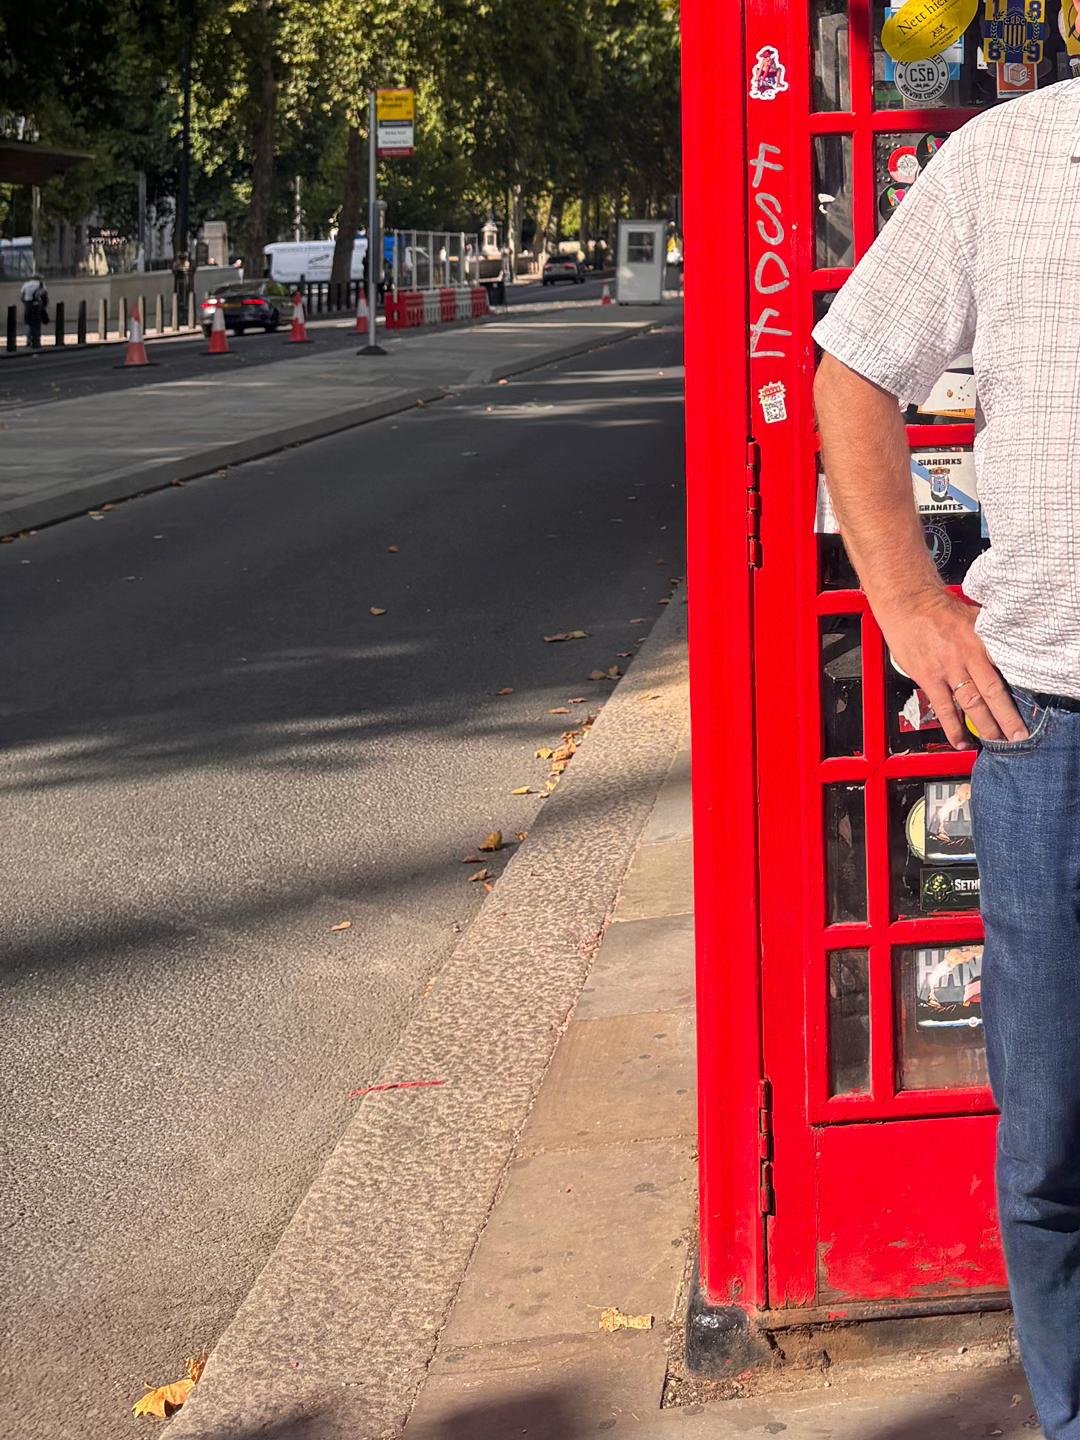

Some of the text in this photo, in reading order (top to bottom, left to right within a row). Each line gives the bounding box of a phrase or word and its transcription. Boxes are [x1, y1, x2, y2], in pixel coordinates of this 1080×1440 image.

[897, 11, 927, 36] Nett
[909, 67, 935, 83] CSB
[918, 503, 964, 512] GRANATES
